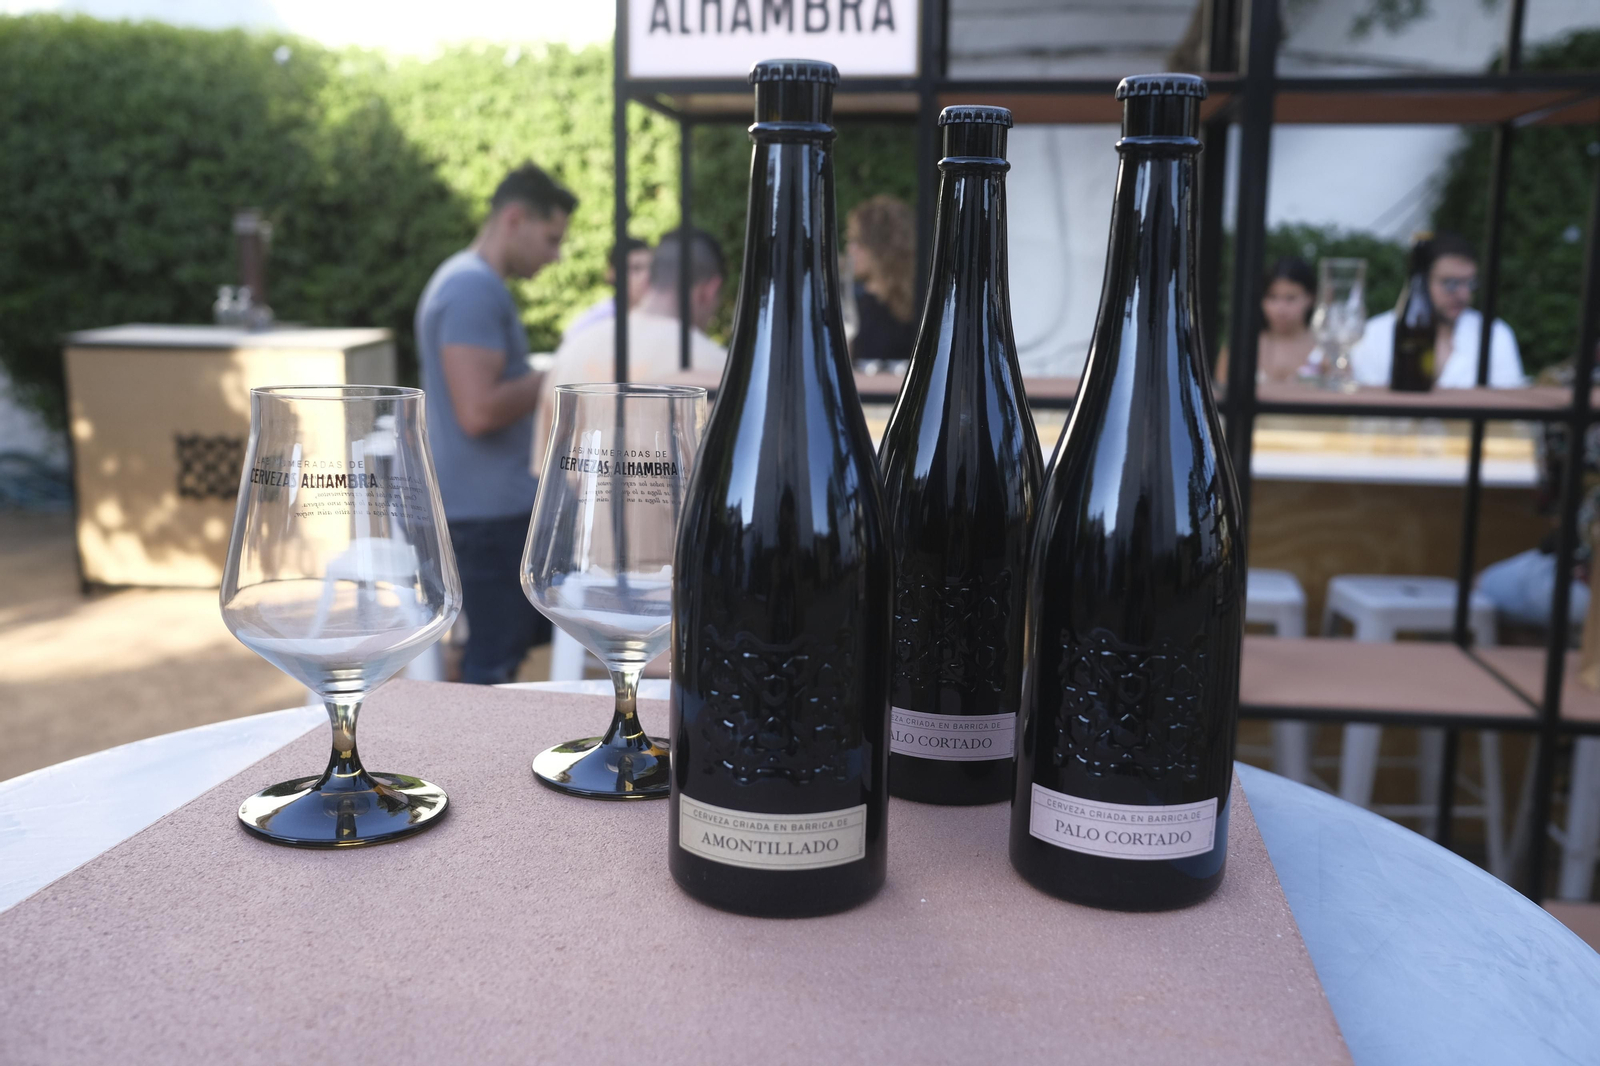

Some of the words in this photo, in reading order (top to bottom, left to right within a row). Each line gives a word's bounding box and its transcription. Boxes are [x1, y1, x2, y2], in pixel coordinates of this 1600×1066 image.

[650, 0, 896, 33] ALHAMBRA
[272, 457, 343, 468] MERADAS
[349, 460, 364, 468] DE
[567, 445, 583, 454] LAS
[587, 447, 651, 458] NUMERADAS
[655, 450, 668, 458] DE
[560, 456, 609, 475] CERVEZAS
[614, 461, 678, 476] ALHAMBRA
[250, 467, 297, 488] CERVEZAS
[301, 473, 379, 489] ALHAMBRA
[906, 717, 936, 728] CRIADA
[952, 722, 989, 730] BARRICA
[918, 735, 993, 750] CORTADO
[692, 808, 730, 826] CERVEZA
[732, 819, 770, 831] CRIADA
[774, 823, 787, 832] EN
[791, 820, 834, 832] BARRICA
[836, 818, 848, 827] DE
[1046, 798, 1086, 815] CERVEZA
[1089, 809, 1127, 822] CRIADA
[1130, 814, 1144, 823] EN
[1147, 812, 1189, 823] BARRICA
[1190, 811, 1201, 820] DE
[1055, 818, 1100, 842] PALO
[1104, 830, 1192, 846] CORTADO
[701, 831, 839, 856] AMONTILLADO
